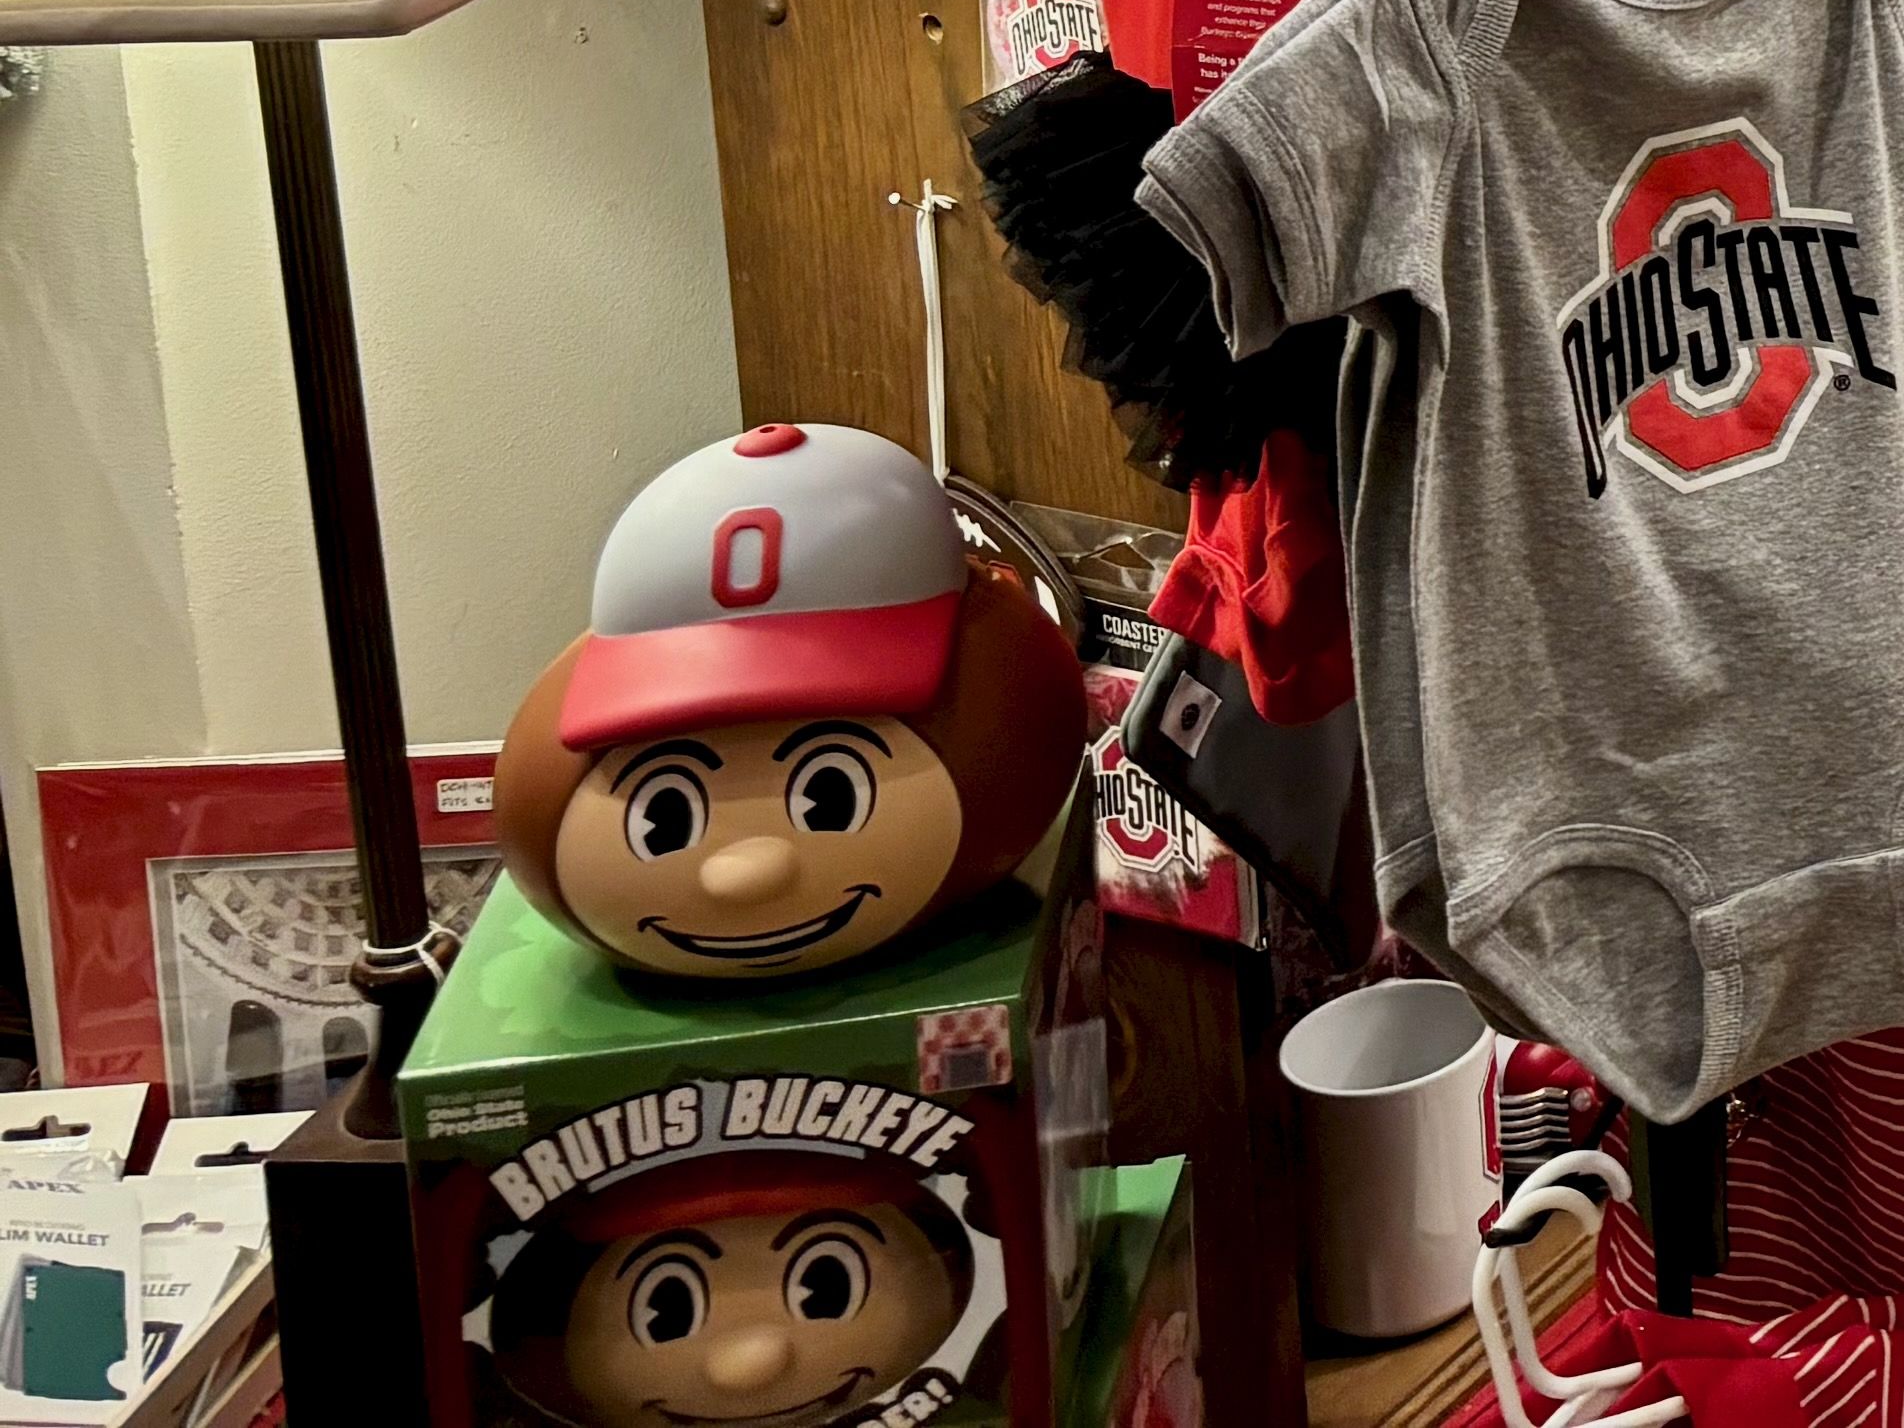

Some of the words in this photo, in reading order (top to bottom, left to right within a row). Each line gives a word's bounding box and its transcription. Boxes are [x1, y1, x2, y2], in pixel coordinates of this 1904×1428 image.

[428, 1111, 528, 1139] Product
[489, 1077, 702, 1224] BRUTUS
[723, 1072, 977, 1170] BUCKEYE
[6, 1177, 86, 1195] APEX
[33, 1229, 110, 1250] WALLET
